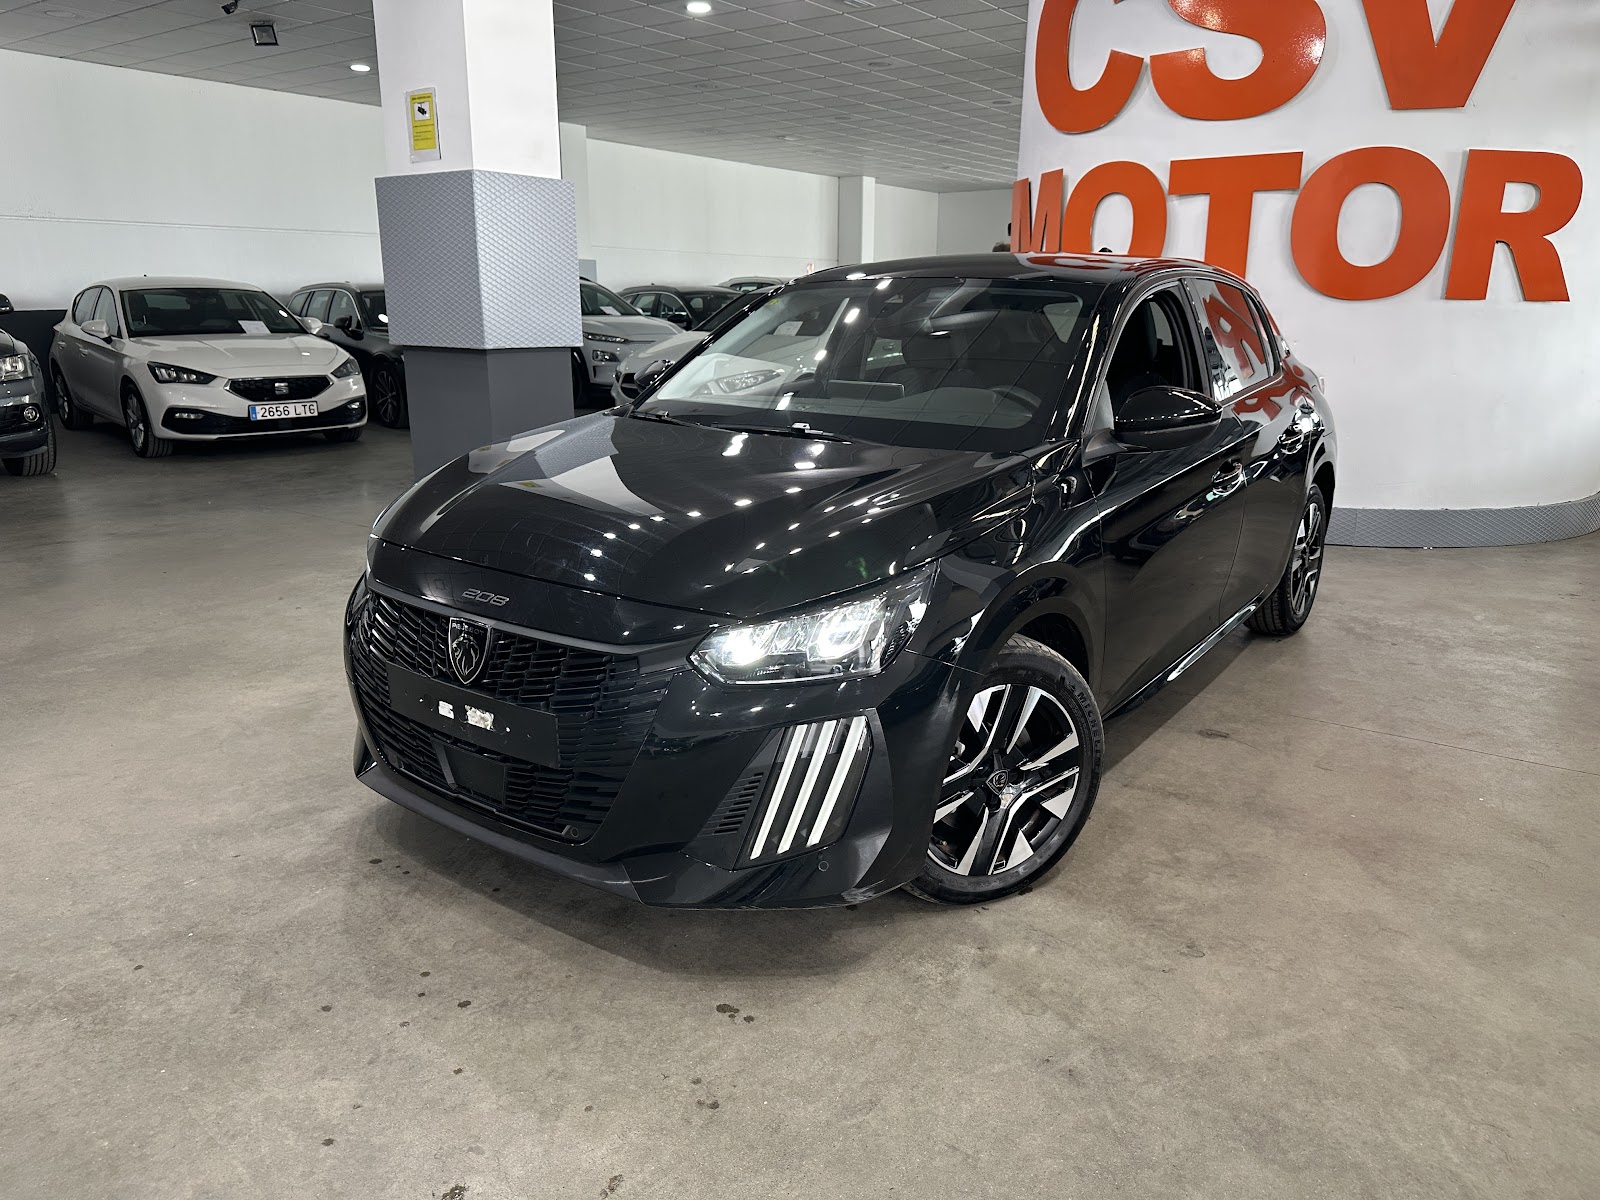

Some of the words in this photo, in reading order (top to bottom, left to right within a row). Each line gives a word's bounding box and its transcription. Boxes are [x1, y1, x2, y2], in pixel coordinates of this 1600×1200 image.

[1035, 0, 1517, 134] CSV
[1010, 146, 1583, 302] MOTOR
[260, 405, 290, 418] 2656
[461, 588, 510, 606] 208
